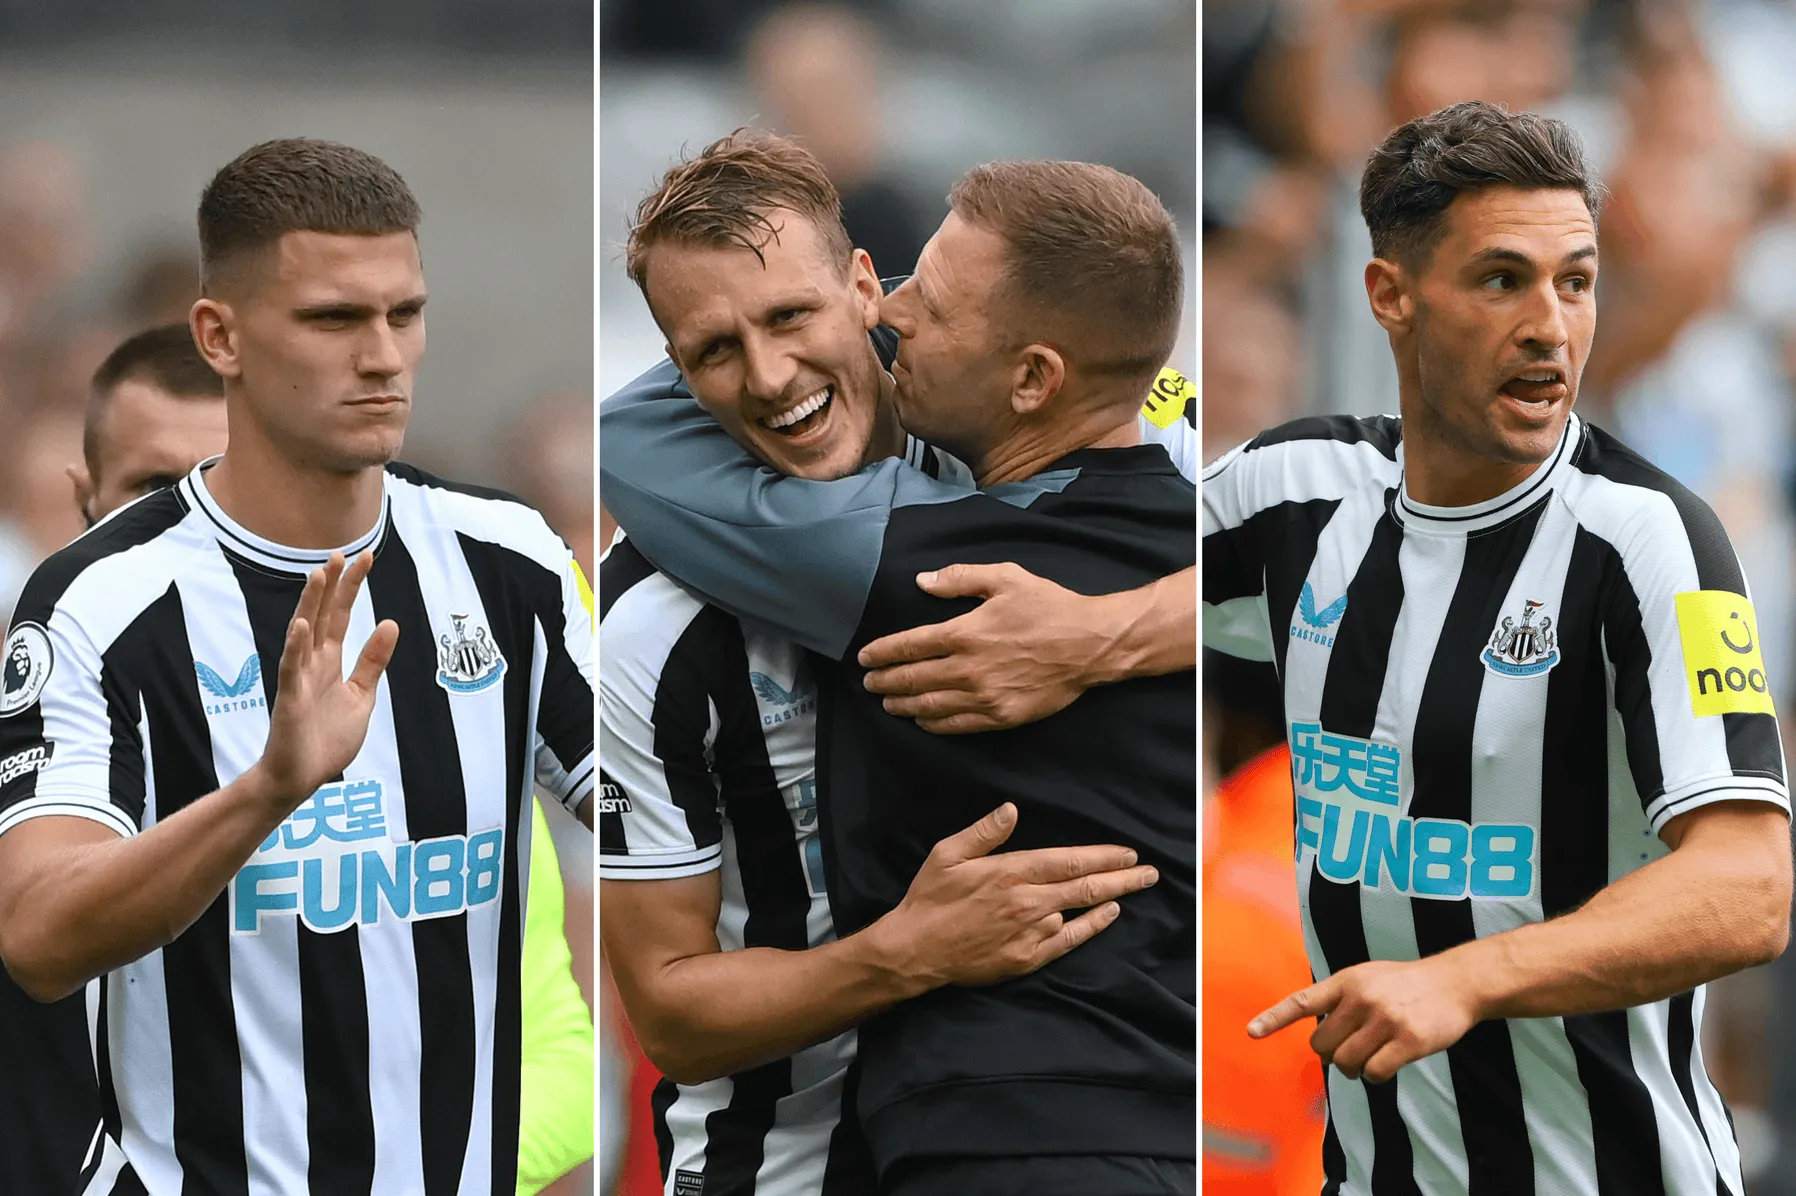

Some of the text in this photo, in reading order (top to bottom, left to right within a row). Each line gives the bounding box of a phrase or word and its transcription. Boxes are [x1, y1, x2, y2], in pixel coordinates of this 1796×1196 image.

[1290, 626, 1334, 648] CASTORE
[1696, 666, 1767, 695] noo
[206, 697, 265, 715] CASTORE
[0, 746, 45, 773] room
[1295, 795, 1535, 897] FUN88
[234, 828, 503, 931] FUN88
